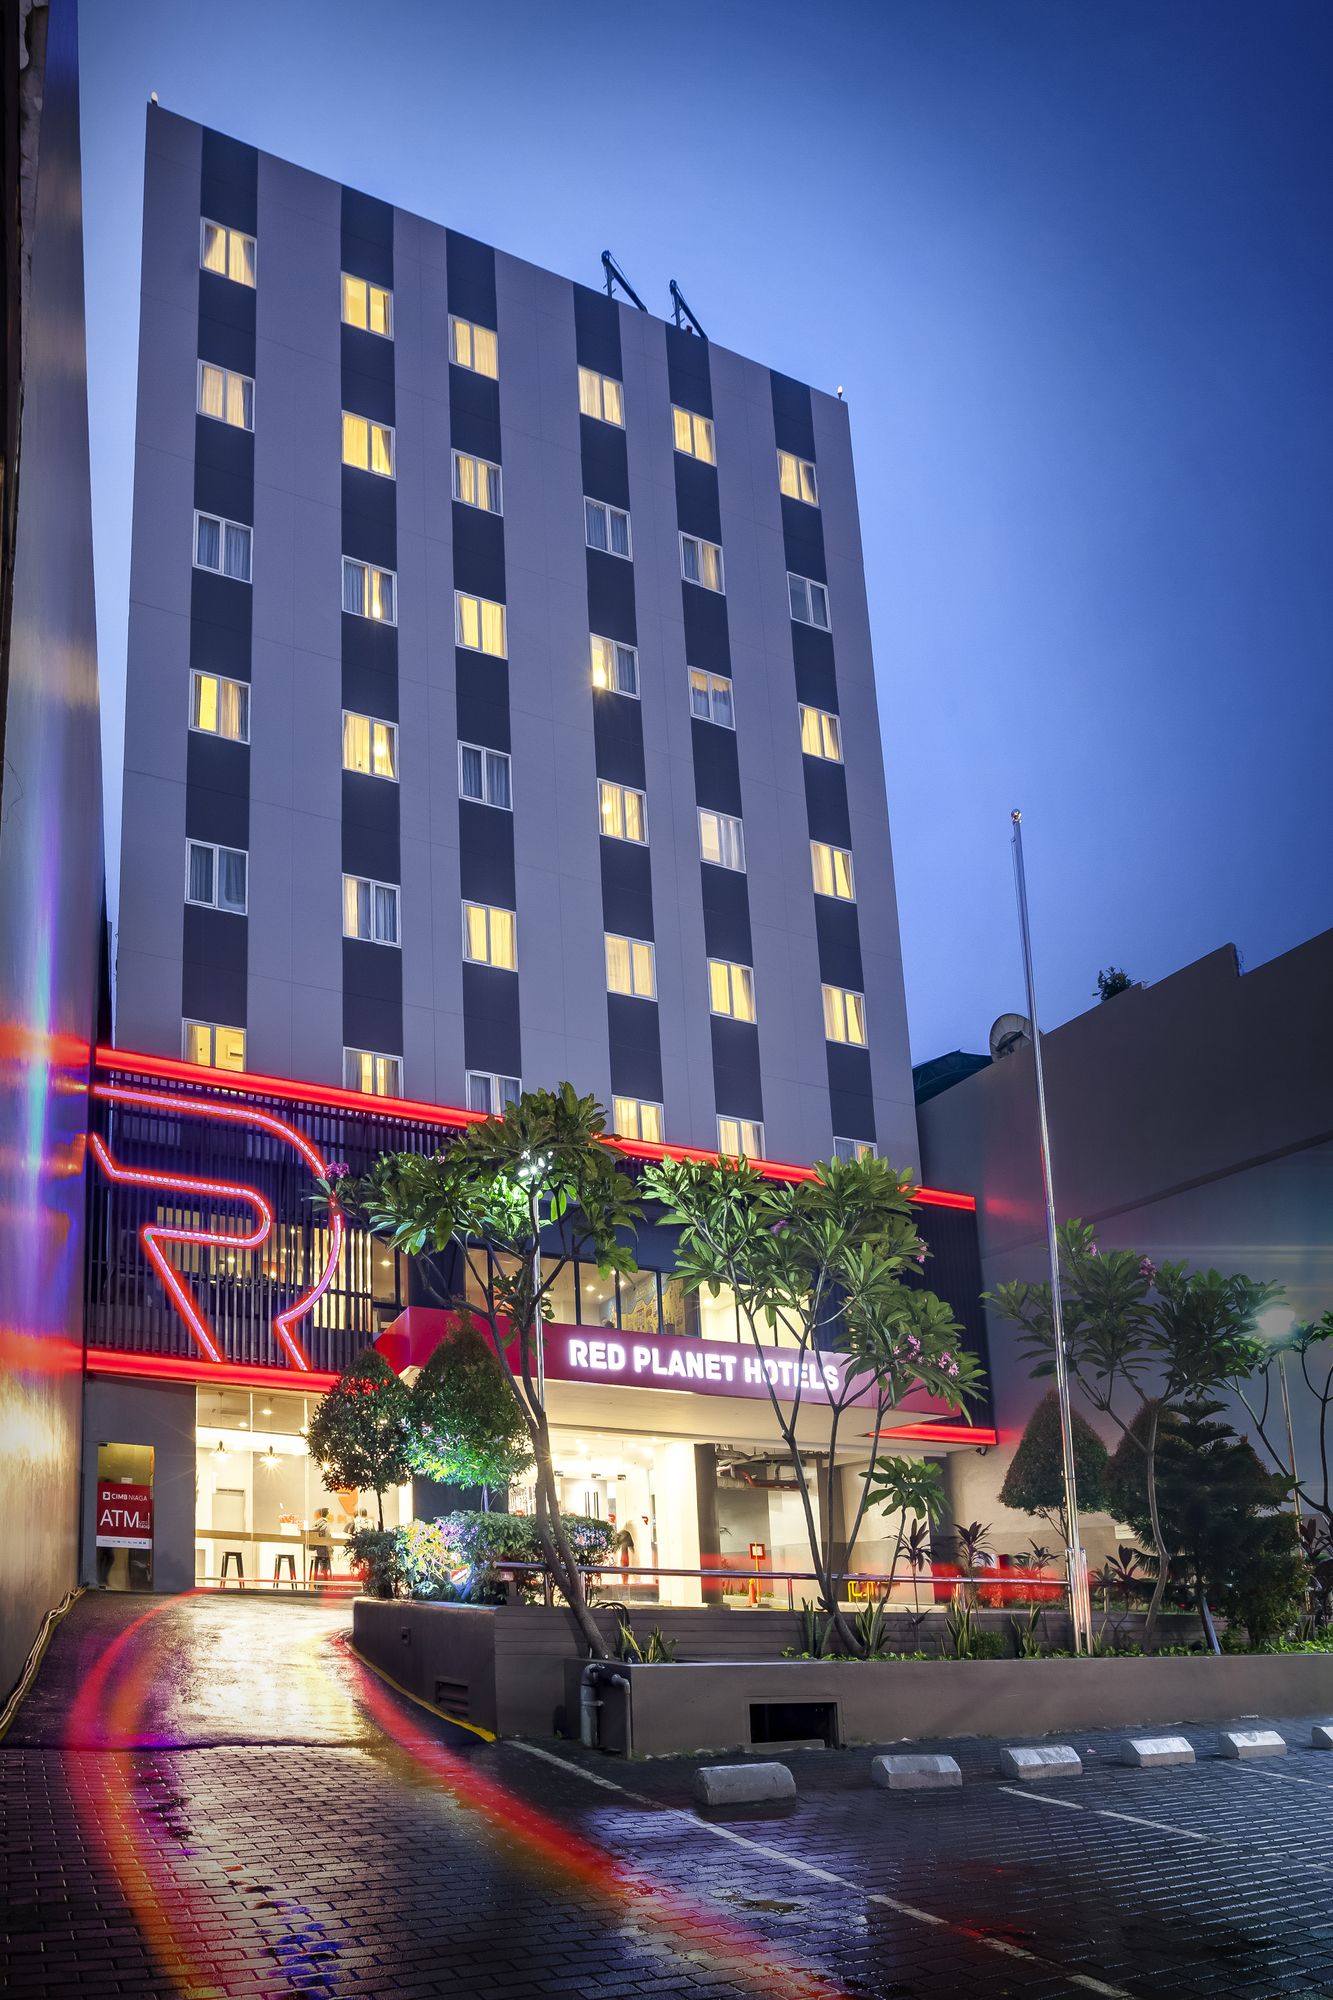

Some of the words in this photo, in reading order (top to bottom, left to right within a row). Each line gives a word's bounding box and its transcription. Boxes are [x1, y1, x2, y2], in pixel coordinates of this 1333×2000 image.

[568, 1339, 626, 1371] RED
[633, 1346, 737, 1381] PLANET
[744, 1356, 840, 1391] HOTELS
[100, 1509, 139, 1528] ATM
